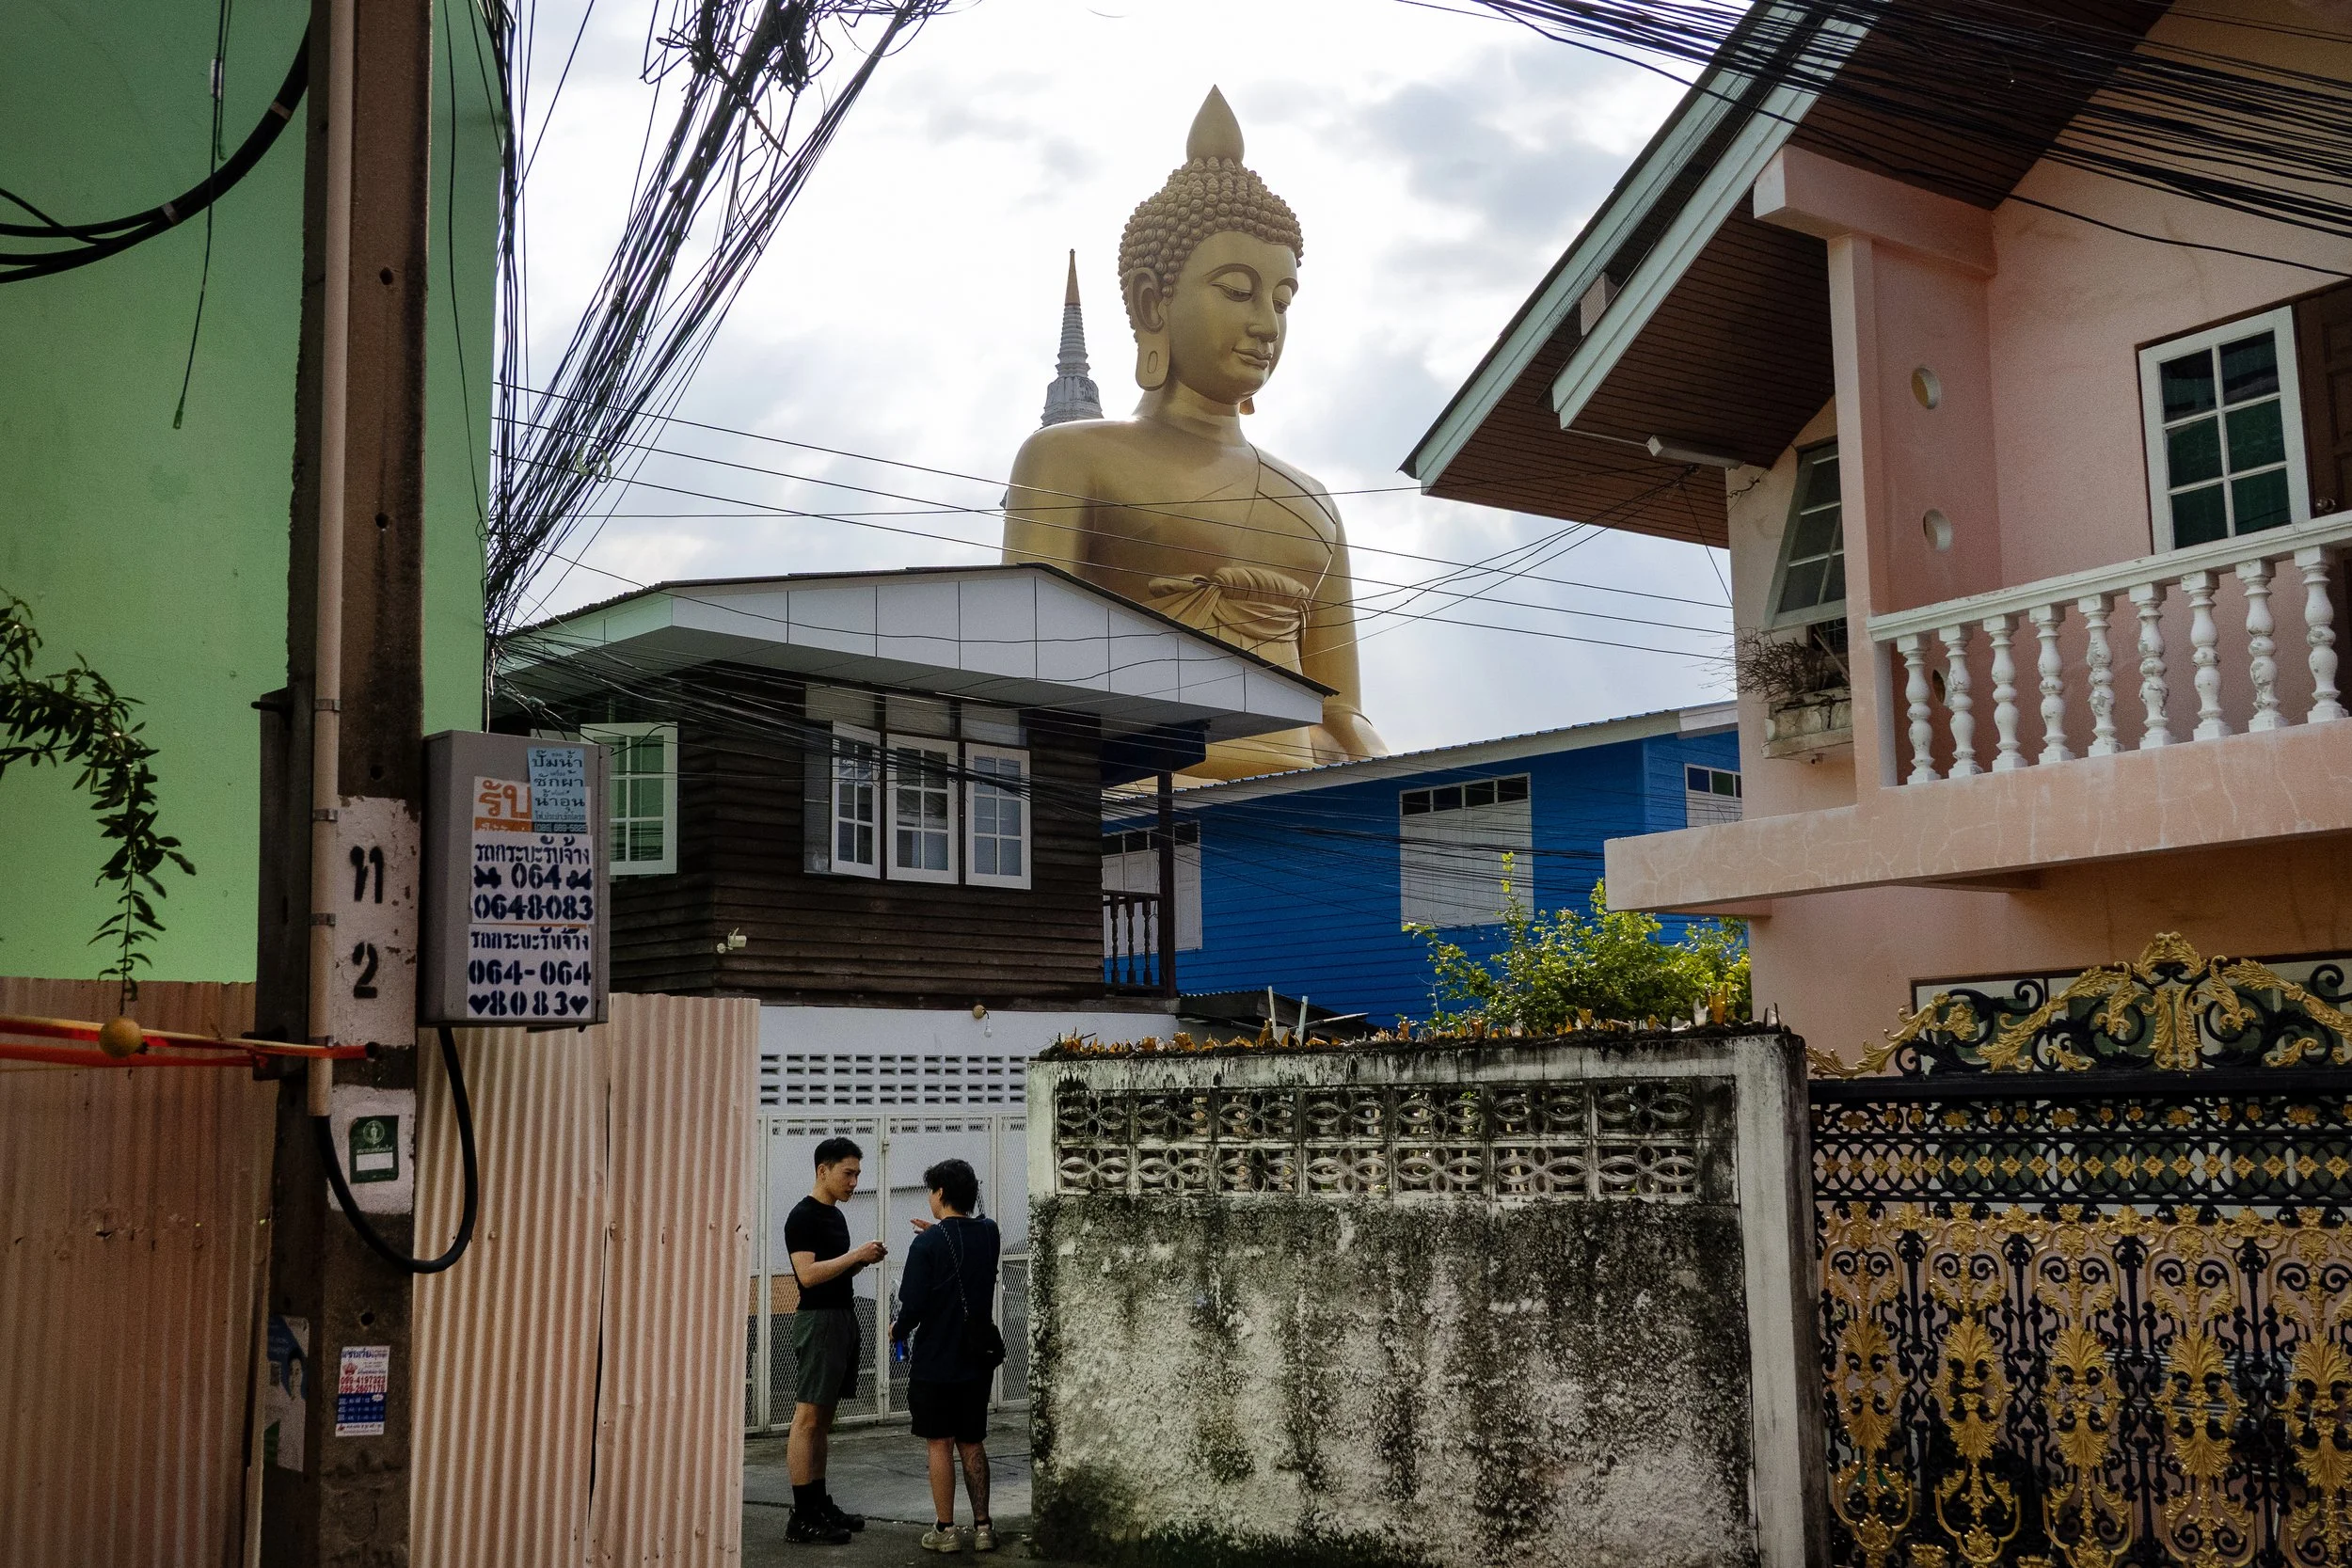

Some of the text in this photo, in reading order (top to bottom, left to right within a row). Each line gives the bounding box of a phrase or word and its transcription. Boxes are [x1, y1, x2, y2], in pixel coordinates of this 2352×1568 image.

[533, 770, 583, 787] ซักผ้า
[534, 789, 586, 815] น้ำอุ่น
[511, 863, 562, 890] 064
[351, 942, 378, 999] 2
